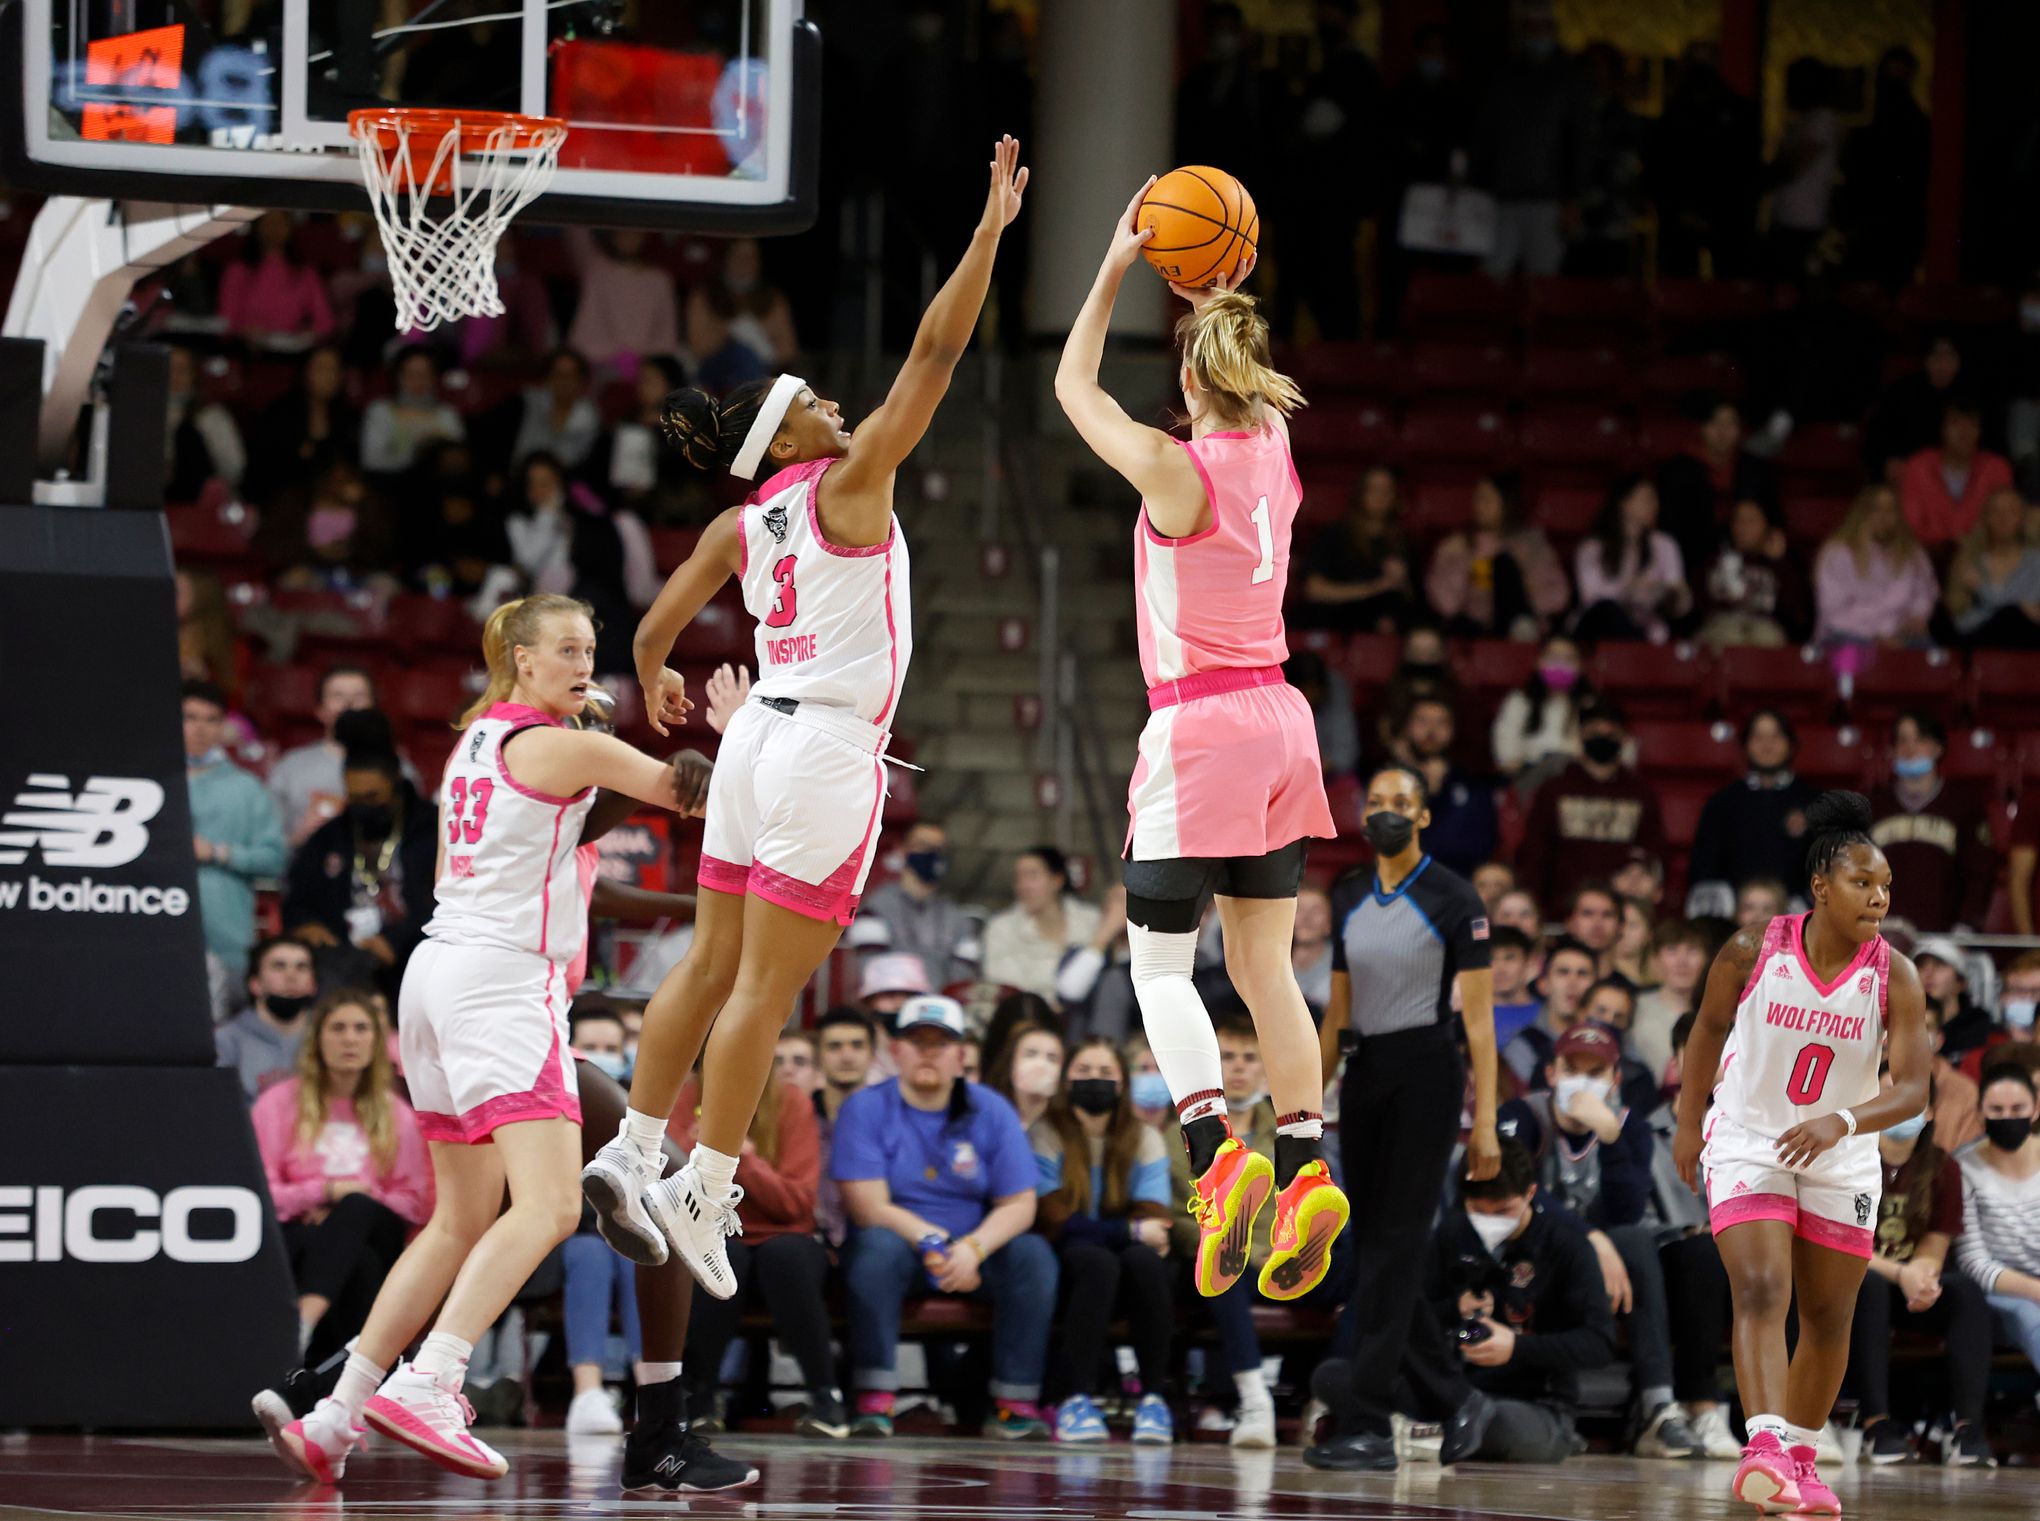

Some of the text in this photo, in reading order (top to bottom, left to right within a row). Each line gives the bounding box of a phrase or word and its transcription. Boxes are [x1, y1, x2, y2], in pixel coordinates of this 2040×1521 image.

[1250, 494, 1274, 585] 1
[765, 554, 798, 628] 3
[766, 633, 817, 665] INSPIRE
[447, 776, 495, 844] 33
[28, 875, 190, 916] balance
[1766, 1001, 1865, 1041] WOLFPACK
[1786, 1042, 1835, 1106] 0
